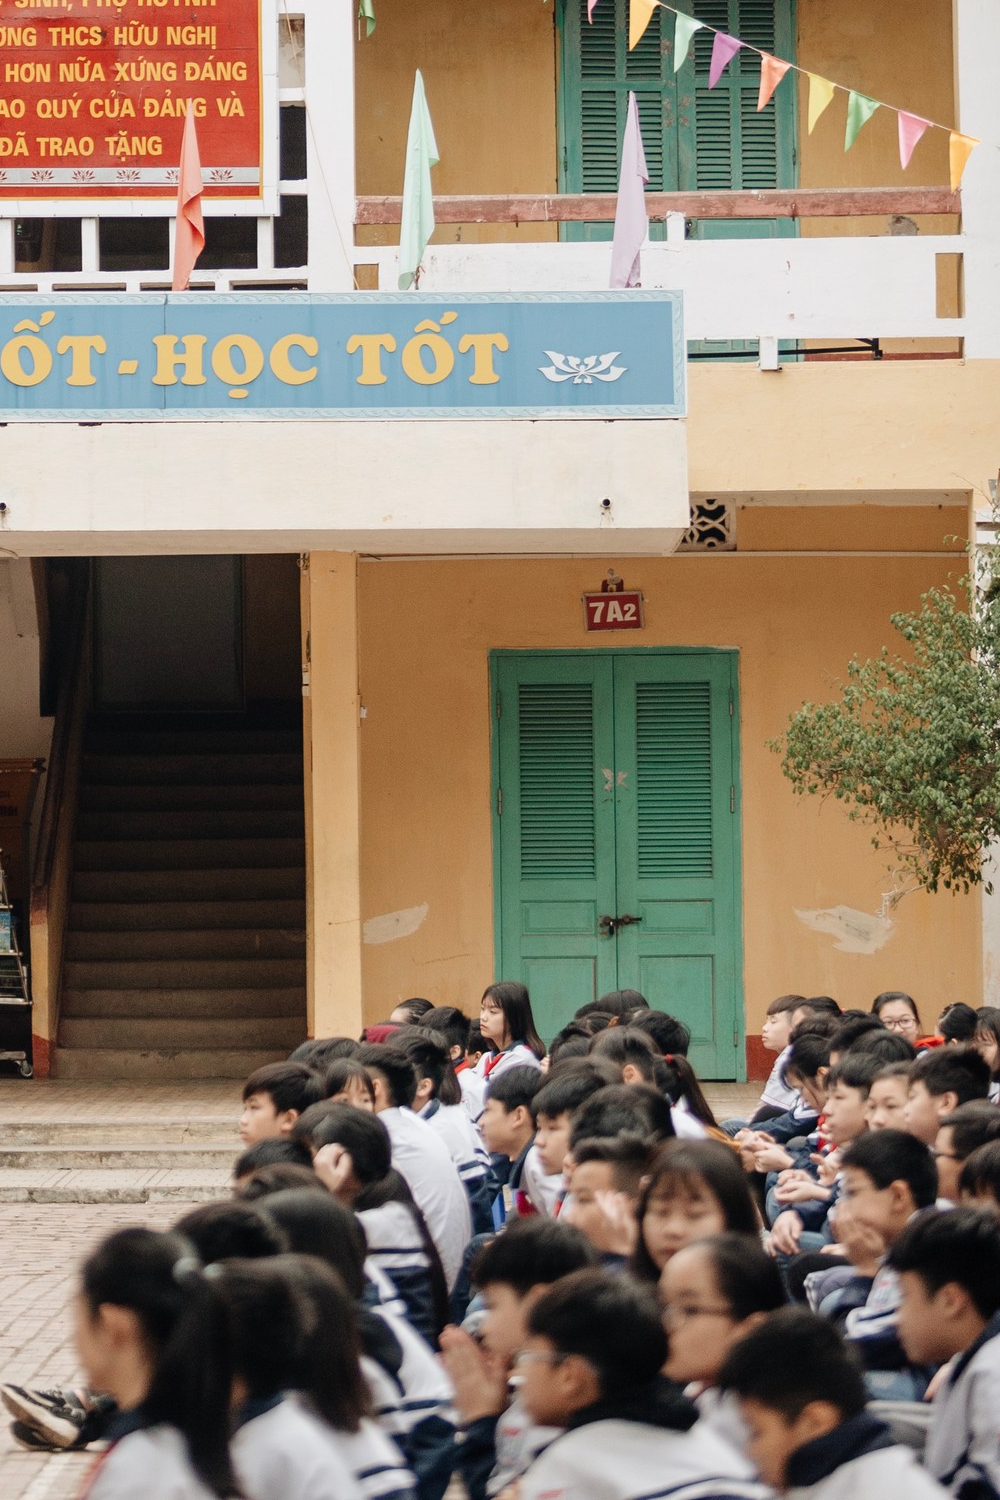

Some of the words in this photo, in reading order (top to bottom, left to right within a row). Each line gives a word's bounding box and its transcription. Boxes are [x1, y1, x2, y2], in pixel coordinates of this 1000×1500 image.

[48, 27, 102, 46] THCS
[114, 20, 158, 46] HỮU
[167, 26, 217, 49] NGHỊ
[6, 62, 50, 82] HƠN
[59, 57, 105, 82] NỮA
[114, 56, 177, 82] XỨNG
[184, 55, 247, 81] ĐÁNG
[36, 92, 82, 119] QUÝ
[90, 90, 135, 118] CỦA
[143, 89, 207, 117] ĐẢNG
[217, 91, 245, 117] VÀ
[36, 137, 94, 156] TRAO
[105, 131, 163, 162] TẶNG
[152, 332, 319, 399] HỌC
[346, 311, 509, 386] TỐT
[589, 601, 637, 623] 7A2
